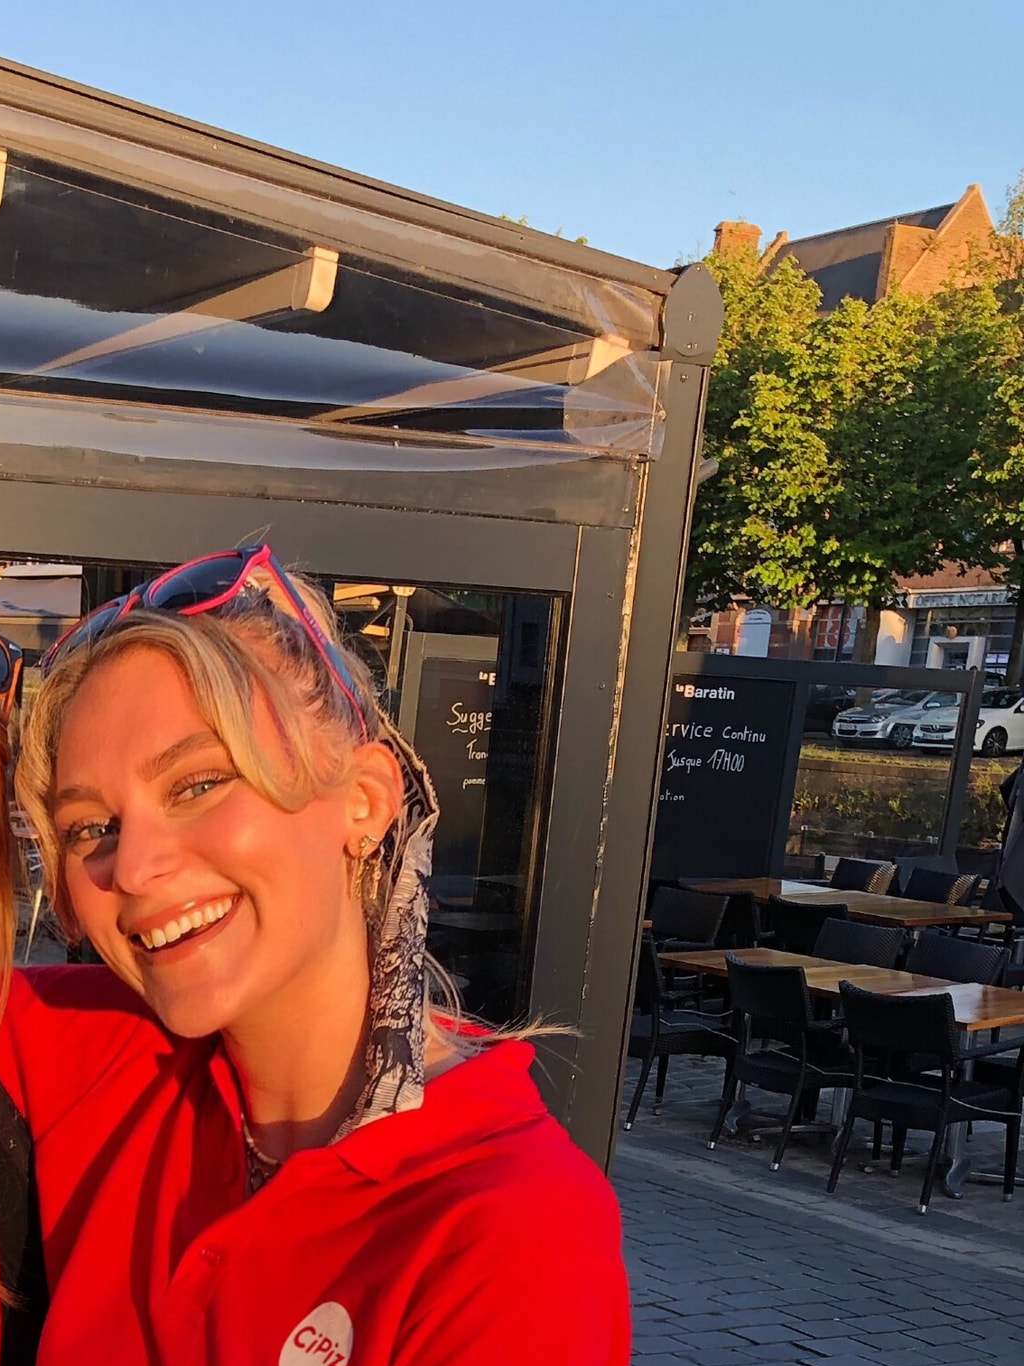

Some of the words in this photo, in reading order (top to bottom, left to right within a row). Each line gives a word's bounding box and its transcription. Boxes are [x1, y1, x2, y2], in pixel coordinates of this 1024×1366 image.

[684, 685, 735, 700] Baratin
[722, 726, 766, 743] Continu
[667, 749, 702, 774] Jusque
[707, 749, 745, 772] 17H00
